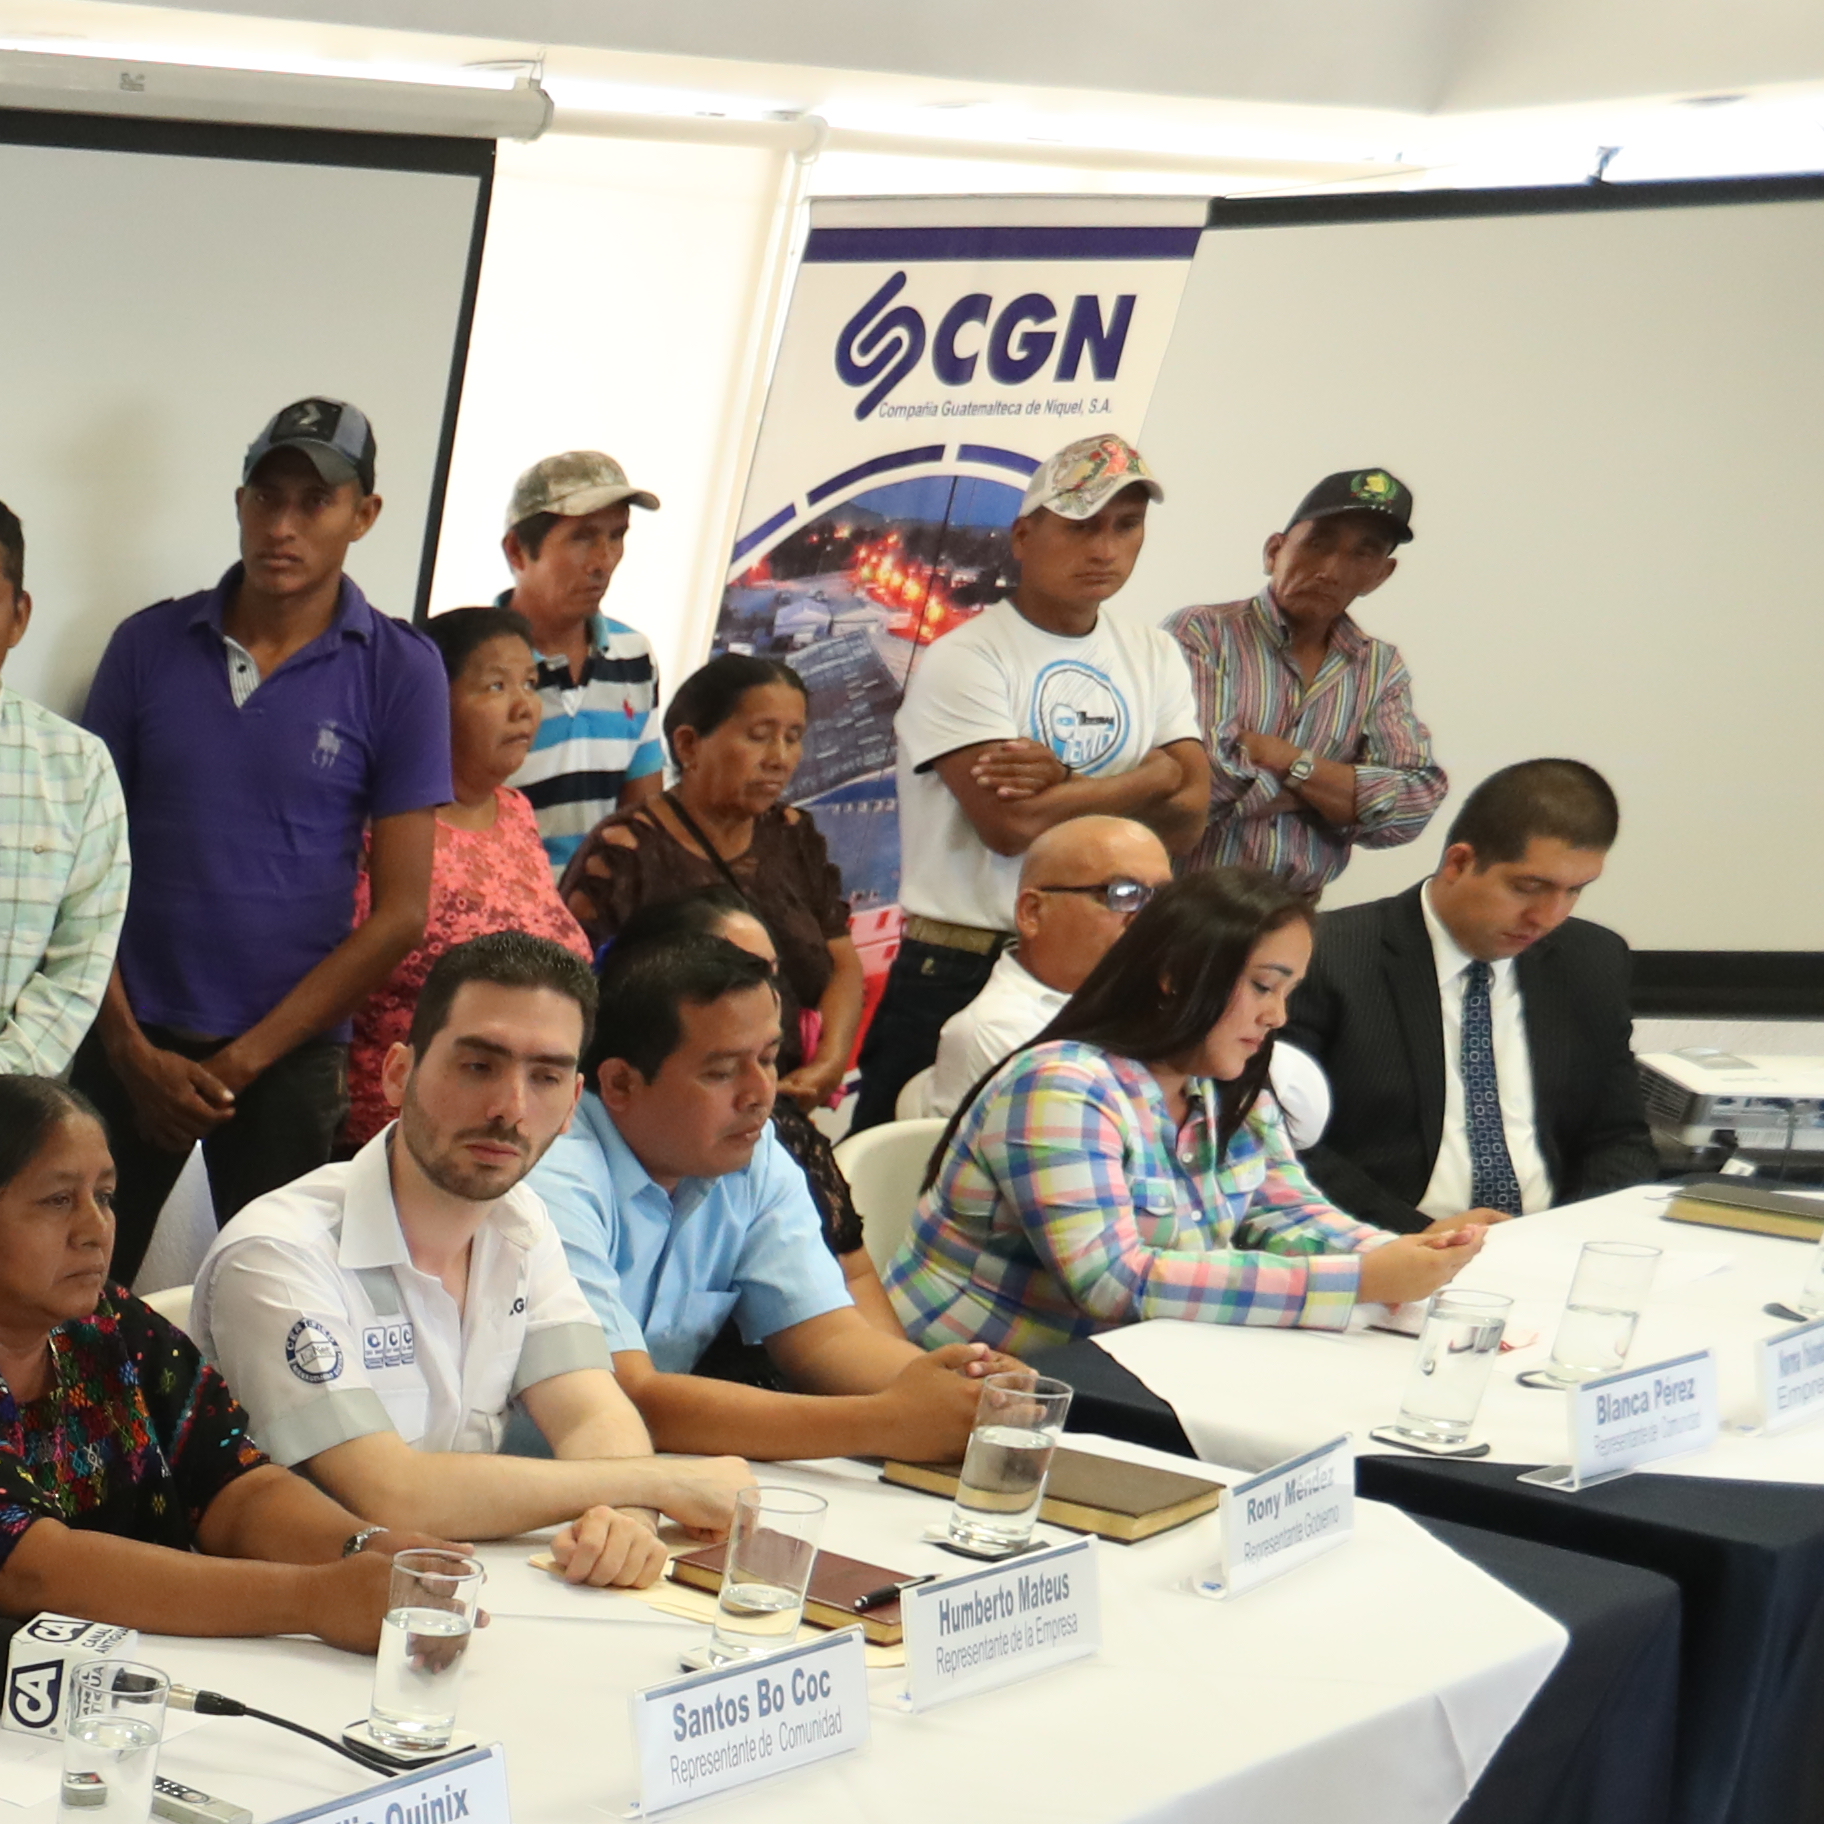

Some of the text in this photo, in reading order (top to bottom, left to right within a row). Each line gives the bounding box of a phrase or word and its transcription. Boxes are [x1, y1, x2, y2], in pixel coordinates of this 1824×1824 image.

[932, 293, 1137, 386] CGN
[941, 399, 1022, 417] Guatemalteca
[1025, 400, 1041, 415] de
[1596, 1389, 1650, 1426] Blanca
[1247, 1492, 1281, 1525] Rony
[939, 1572, 1070, 1636] Humberto Mateus
[936, 1612, 1078, 1678] Representante de la Empresa
[672, 1667, 831, 1743] Santos Bo Coc
[669, 1705, 842, 1788] Representante de Comunidad
